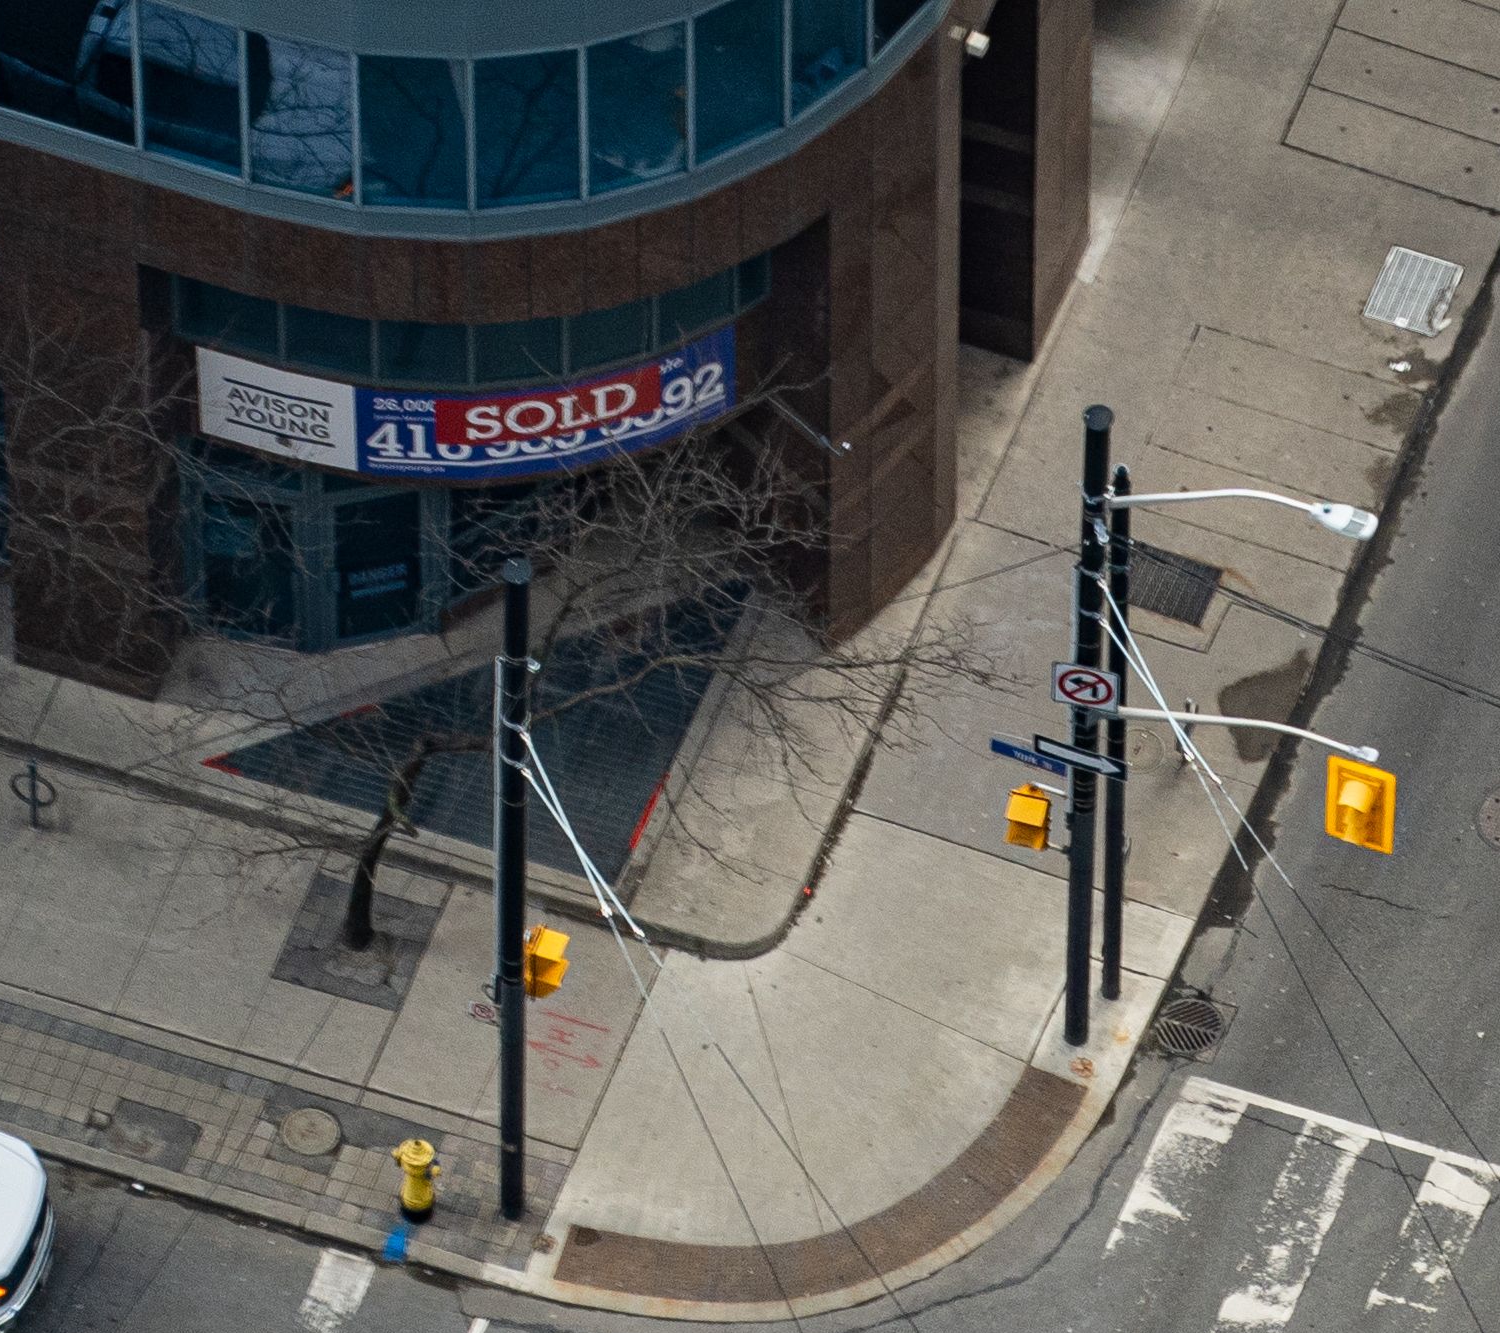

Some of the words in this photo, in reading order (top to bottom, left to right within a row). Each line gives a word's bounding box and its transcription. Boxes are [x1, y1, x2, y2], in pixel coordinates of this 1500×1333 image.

[227, 386, 330, 423] AVISON
[228, 402, 331, 439] YOUNG
[465, 383, 637, 440] SOLD
